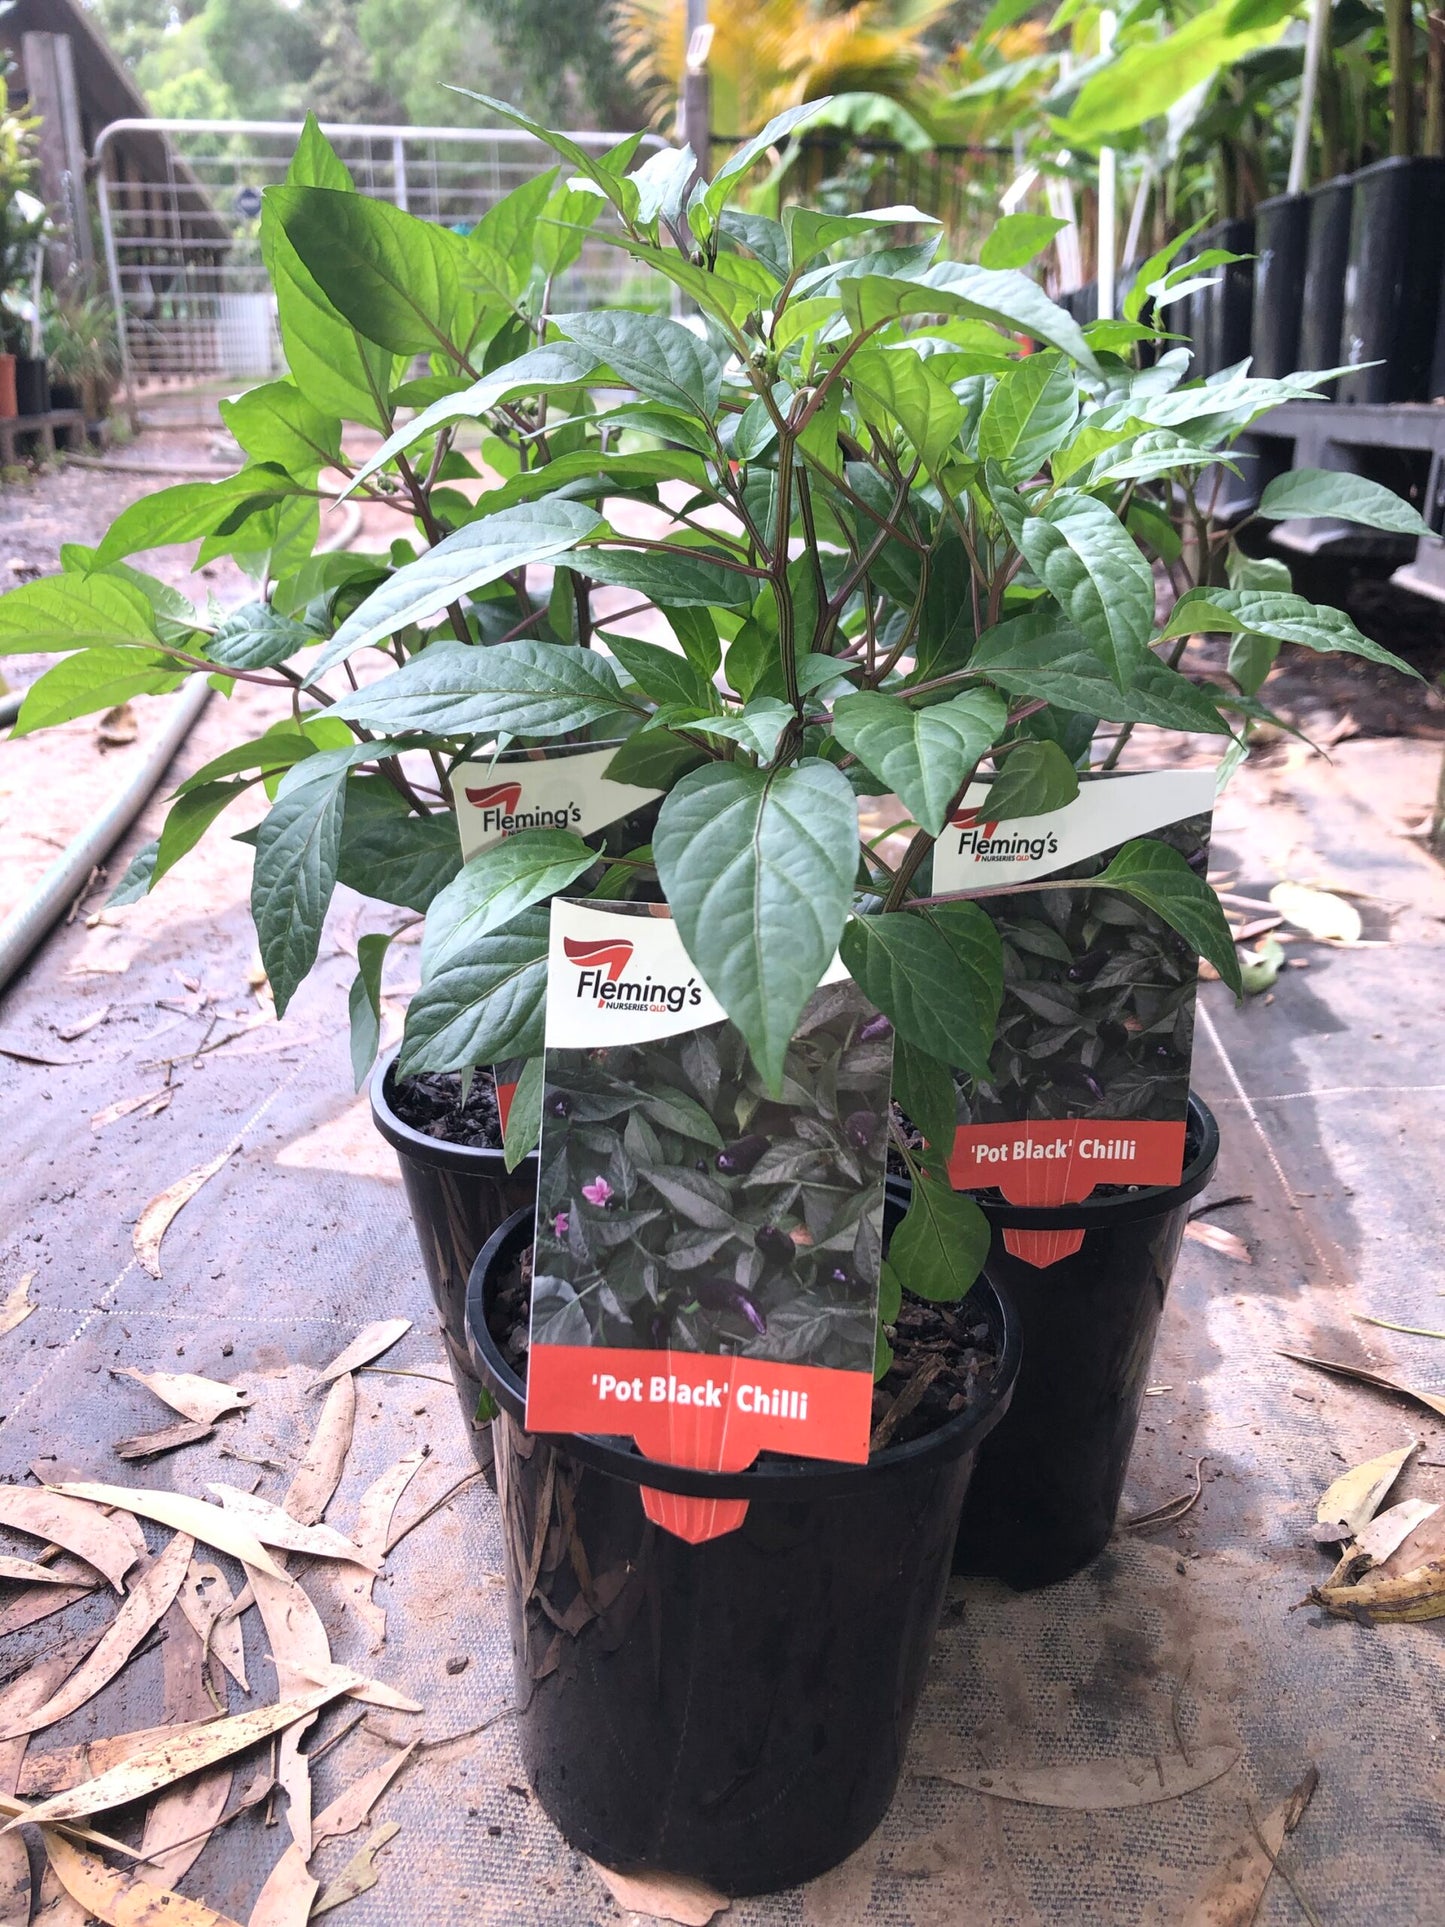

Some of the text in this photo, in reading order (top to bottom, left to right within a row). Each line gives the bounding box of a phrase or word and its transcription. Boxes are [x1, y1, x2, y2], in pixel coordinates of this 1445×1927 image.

[483, 802, 581, 832] Fleming's
[958, 832, 1058, 860] Fleming's
[577, 970, 702, 1012] Fleming's
[605, 1002, 666, 1013] NURSERIES QLD
[971, 1138, 1137, 1164] 'Pot Black' Chilli
[592, 1374, 809, 1420] 'Pot Black' Chilli
